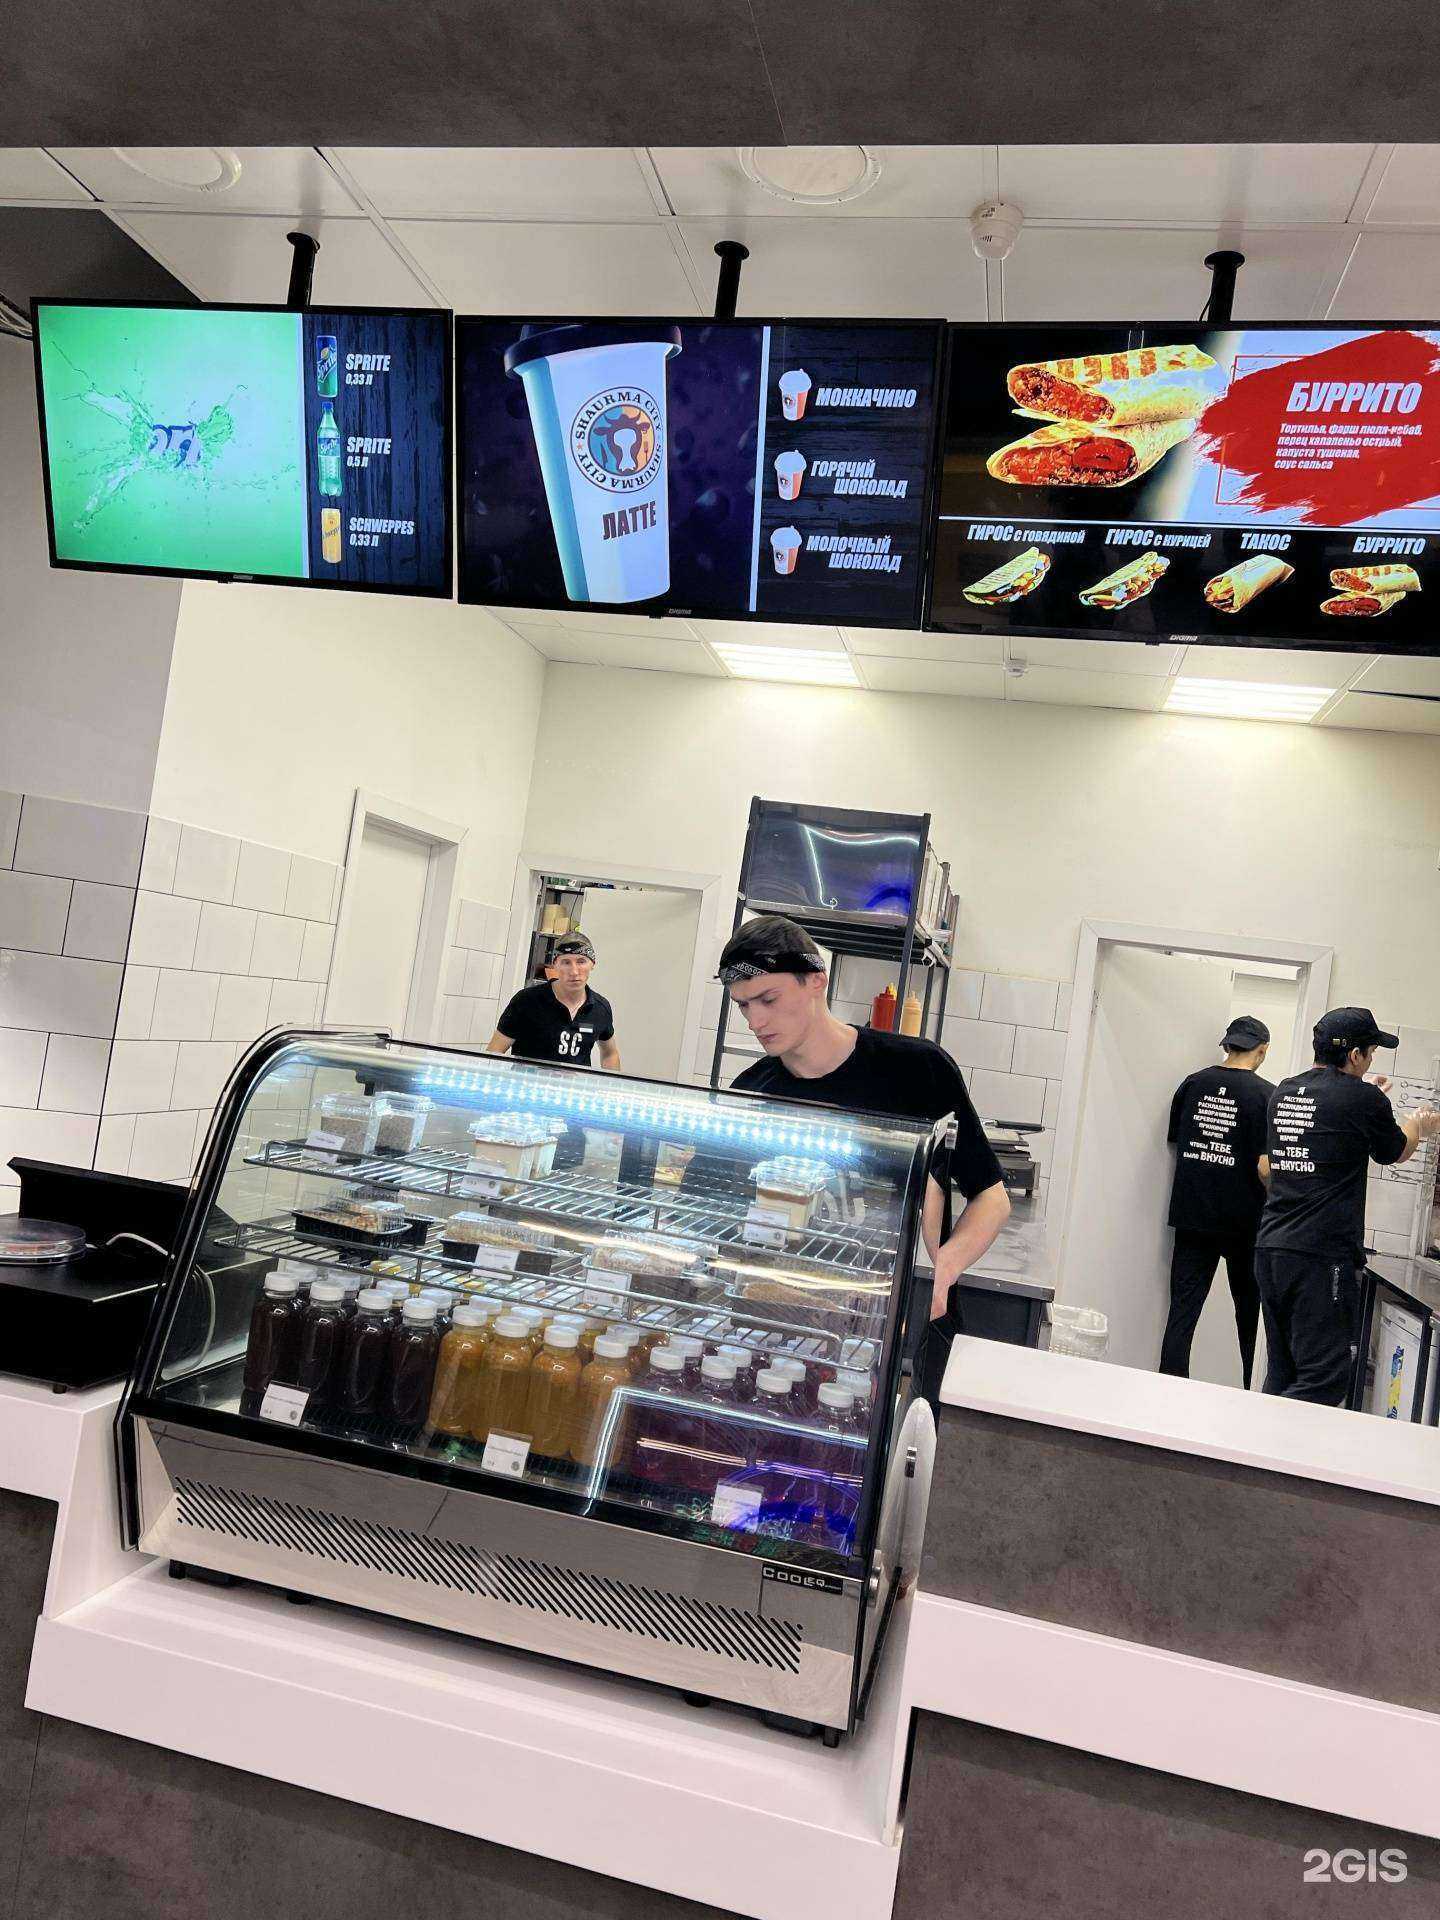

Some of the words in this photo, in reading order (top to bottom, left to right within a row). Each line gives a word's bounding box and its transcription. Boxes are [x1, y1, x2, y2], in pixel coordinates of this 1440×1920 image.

[345, 353, 391, 372] SPRITE
[345, 373, 365, 386] 0,33
[815, 387, 917, 408] МОККАЧИНО
[1286, 381, 1423, 413] БУРРИТО
[575, 391, 641, 440] SHAURMA
[645, 400, 661, 431] CITY
[1328, 424, 1359, 435] фарш
[347, 436, 391, 455] SPRITE
[1277, 436, 1308, 447] перец
[347, 455, 361, 468] 0,5
[1275, 448, 1315, 458] капуста
[578, 453, 607, 483] CITY
[610, 443, 663, 489] SHAURMA
[810, 459, 876, 478] ГОРЯЧИЙ
[1274, 459, 1298, 470] соус
[1297, 460, 1333, 470] сальса
[833, 478, 909, 499] ШОКОЛАД
[349, 517, 415, 535] SCHWEPPES
[602, 500, 657, 540] ЛАТТЕ
[349, 533, 370, 547] 0,33
[967, 524, 1014, 541] ГИРОС
[1105, 528, 1154, 546] ГИРОС
[1240, 532, 1291, 550] ТАКОС
[806, 535, 892, 554] МОЛОЧНЫЙ
[1352, 536, 1427, 555] БУРРИТО
[828, 552, 902, 574] ШОКОЛАД
[558, 1030, 582, 1057] SC
[1218, 1087, 1226, 1095] Я
[1210, 1141, 1232, 1154] ТЕБЕ
[1286, 1147, 1309, 1159] ТЕБЕ
[1200, 1151, 1235, 1166] ВКУСНО
[1280, 1160, 1315, 1172] ВКУСНО
